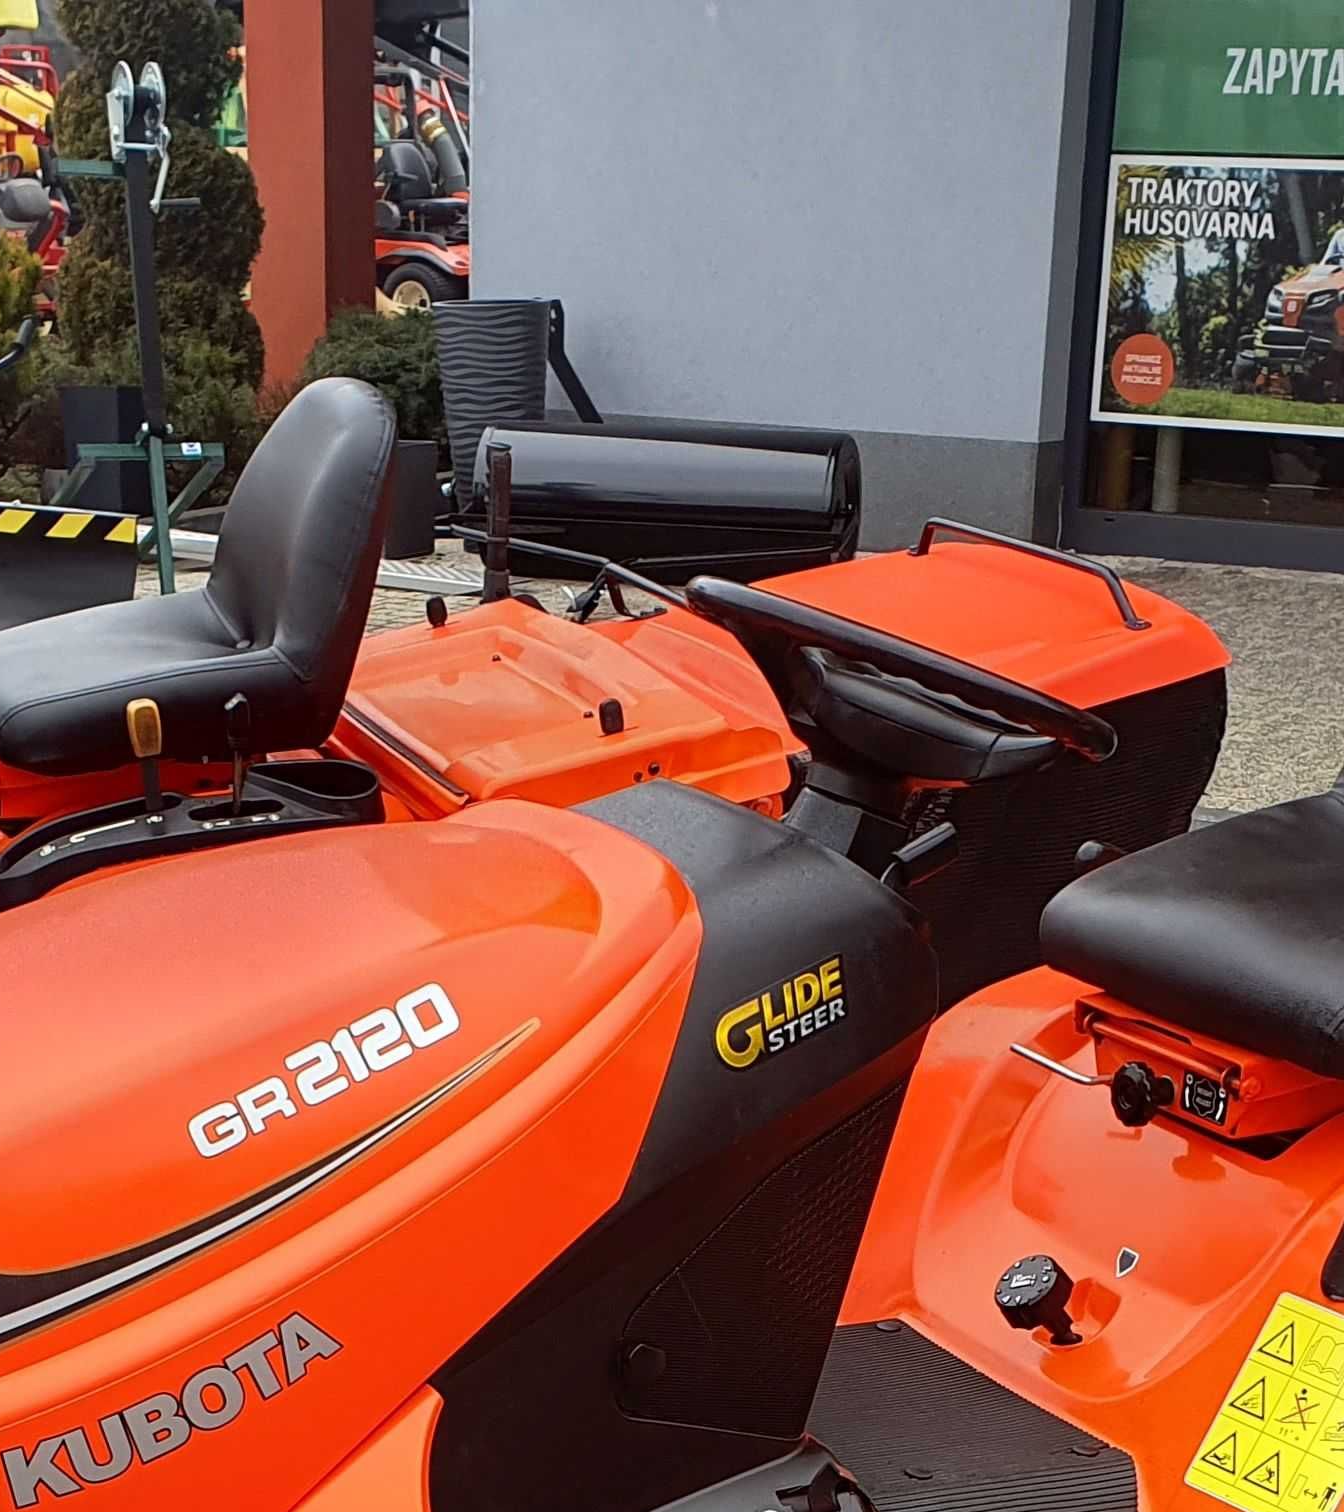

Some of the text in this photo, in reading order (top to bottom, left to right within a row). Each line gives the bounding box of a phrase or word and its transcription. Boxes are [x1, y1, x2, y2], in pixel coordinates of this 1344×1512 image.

[1123, 207, 1276, 241] HUSQVARNA
[1127, 176, 1259, 208] TRAKTORY
[715, 957, 844, 1069] GLIDE
[767, 997, 846, 1053] STEER
[186, 980, 462, 1160] GR2120
[0, 1310, 345, 1510] KUBOTA
